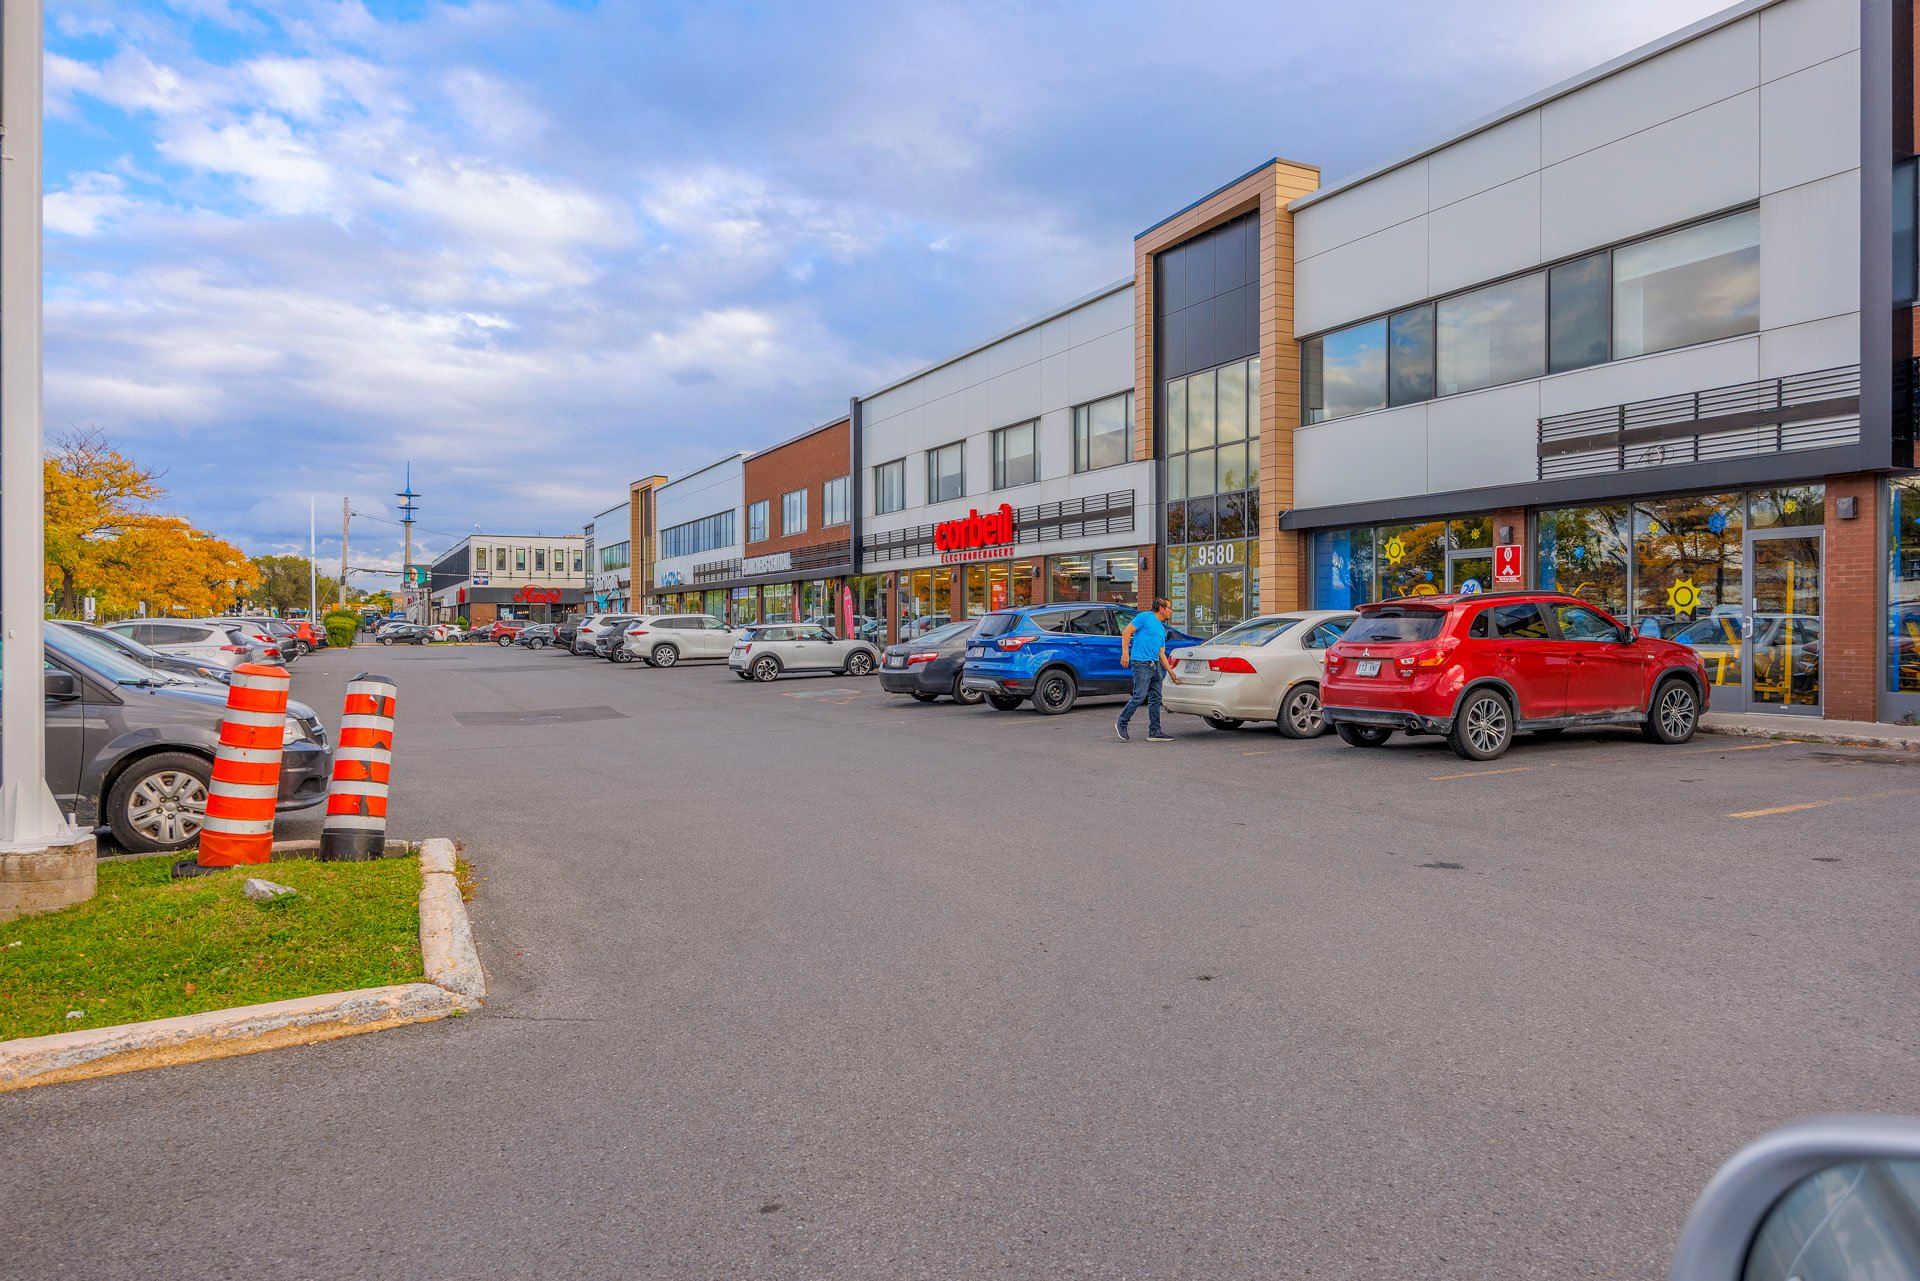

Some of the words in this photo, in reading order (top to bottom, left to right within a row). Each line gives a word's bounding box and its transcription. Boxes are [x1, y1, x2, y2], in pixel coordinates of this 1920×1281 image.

[935, 503, 1013, 551] corbeil
[940, 547, 1014, 563] ÉLECTROMÉNAGERS
[1198, 543, 1234, 566] 9580
[513, 583, 562, 603] Amir
[1463, 583, 1475, 594] 24
